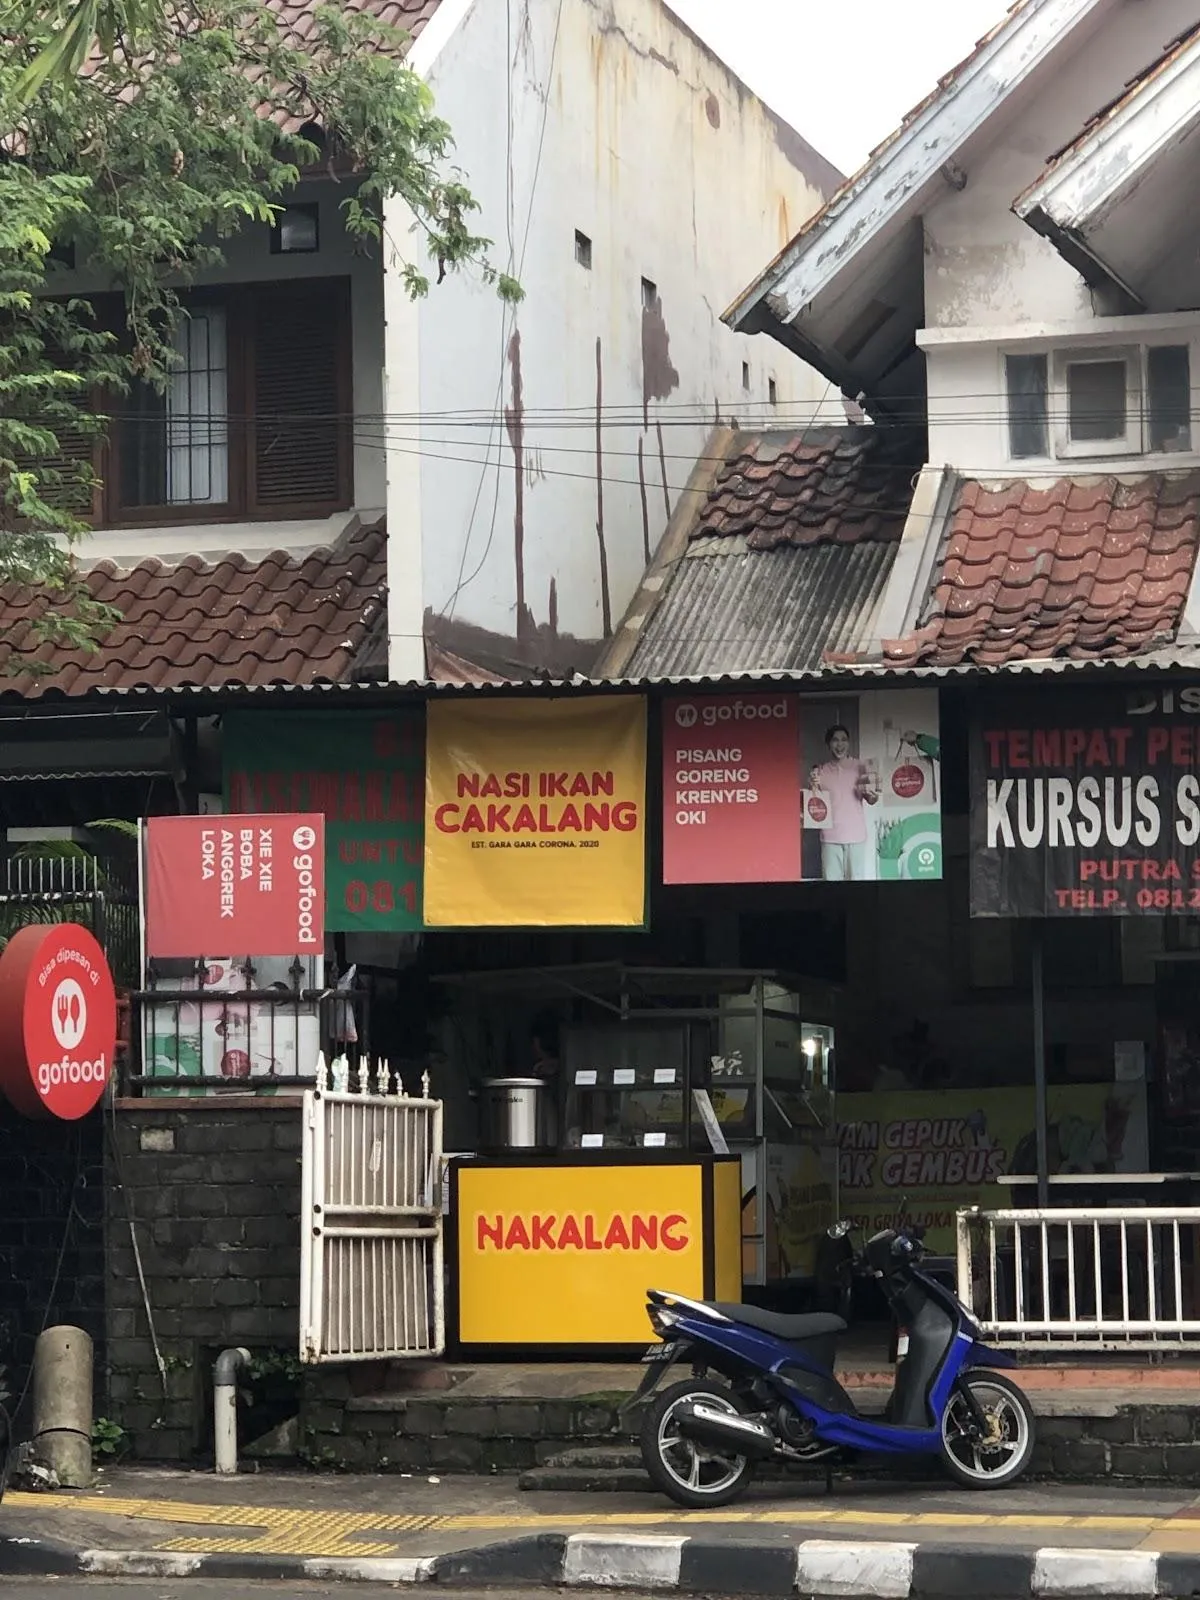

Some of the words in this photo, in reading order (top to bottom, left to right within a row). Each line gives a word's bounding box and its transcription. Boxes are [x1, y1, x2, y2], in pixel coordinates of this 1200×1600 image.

[702, 701, 788, 726] gofood
[676, 748, 742, 763] PISANG
[984, 728, 1132, 768] TEMPAT
[1146, 726, 1200, 767] PE
[457, 772, 530, 798] NASI
[539, 771, 614, 797] IKAN
[676, 768, 750, 784] GORENG
[676, 789, 759, 804] KRENYES
[986, 776, 1161, 848] KURSUS
[434, 801, 638, 833] CAKALANG
[675, 811, 706, 824] OKI
[201, 831, 215, 880] LOKA
[240, 829, 253, 880] BOBA
[259, 829, 273, 857] XIE
[471, 841, 487, 849] EST.
[220, 830, 234, 918] ANGGREK
[259, 863, 273, 892] XIE
[1080, 859, 1181, 881] PUTRA
[293, 854, 317, 943] gofood
[1055, 889, 1127, 908] TELP.
[38, 958, 57, 987] Bisa
[56, 947, 91, 972] dipesan
[89, 969, 101, 986] di
[38, 1052, 105, 1095] gofood
[884, 1118, 966, 1149] GEPUK
[882, 1148, 1006, 1188] GEMBUS
[477, 1215, 689, 1251] NAKALANG
